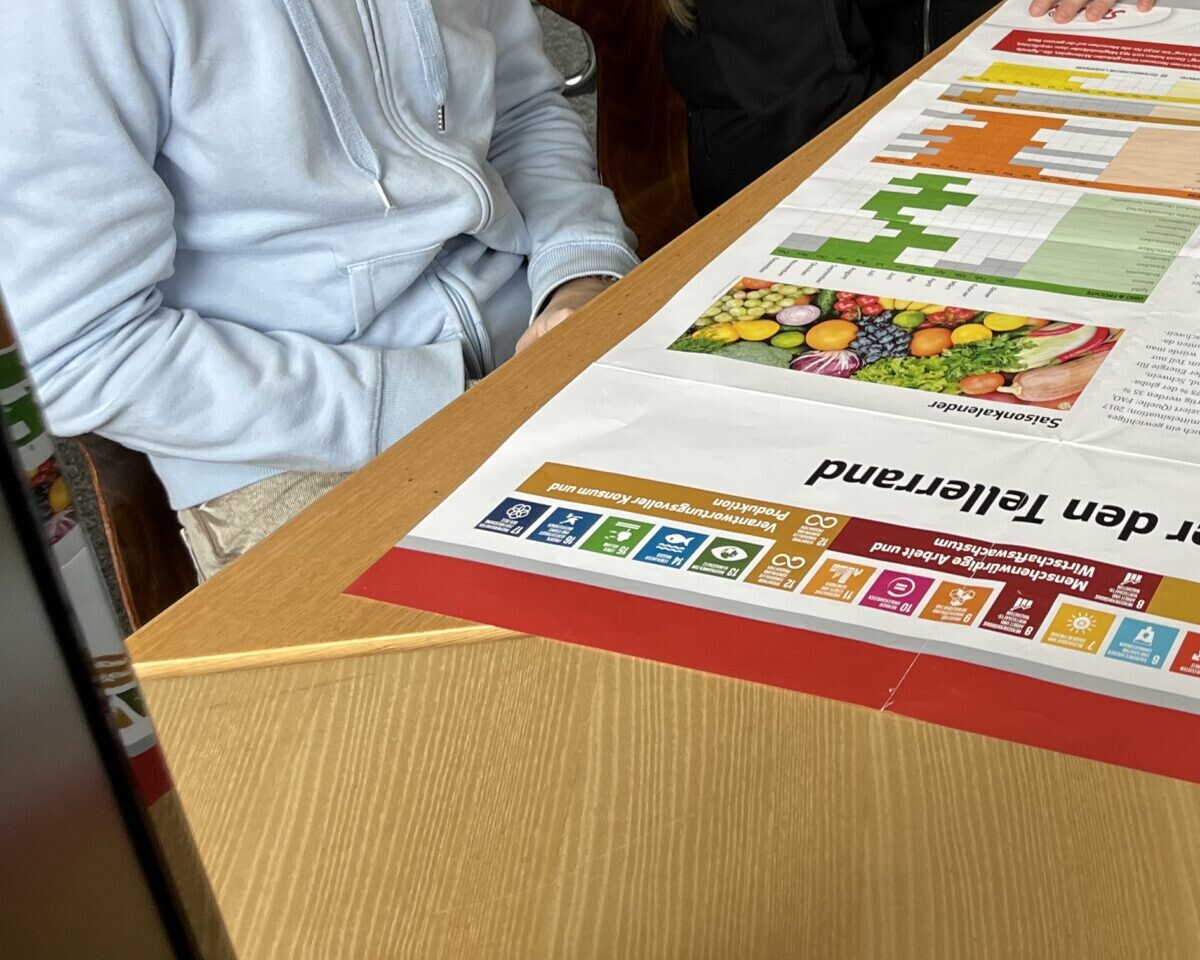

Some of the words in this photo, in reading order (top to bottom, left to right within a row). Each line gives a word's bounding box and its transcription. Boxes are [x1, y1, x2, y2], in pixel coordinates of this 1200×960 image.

[1145, 344, 1166, 352] man
[1167, 348, 1196, 357] würde
[1168, 357, 1185, 365] Teil
[1150, 363, 1187, 375] Energie
[1161, 384, 1178, 392] der
[1146, 391, 1181, 402] werden
[929, 401, 1062, 428] Saisonkalender
[1106, 413, 1164, 428] gewichtiges
[1165, 424, 1181, 432] ein
[546, 482, 576, 492] und
[801, 459, 1048, 523] Tellerrand
[576, 487, 632, 504] Konsum
[712, 498, 790, 520] Produktion
[630, 497, 783, 533] Verantwortungsvoller
[1062, 498, 1158, 541] den
[510, 525, 523, 534] 17
[562, 535, 575, 544] 16
[816, 537, 828, 546] 12
[616, 545, 629, 555] 15
[869, 542, 901, 553] und
[671, 556, 683, 565] 14
[901, 547, 950, 565] Arbeit
[933, 537, 1095, 577] Wirtschaftswachstum
[726, 567, 739, 576] 13
[951, 555, 1092, 591] Menschenwürdige
[782, 578, 795, 588] 12
[842, 590, 853, 599] 11
[899, 602, 912, 612] 10
[1136, 599, 1144, 608] 8
[963, 613, 972, 622] 9
[1024, 626, 1033, 635] 8
[1087, 640, 1095, 649] 7
[1151, 654, 1160, 664] 6
